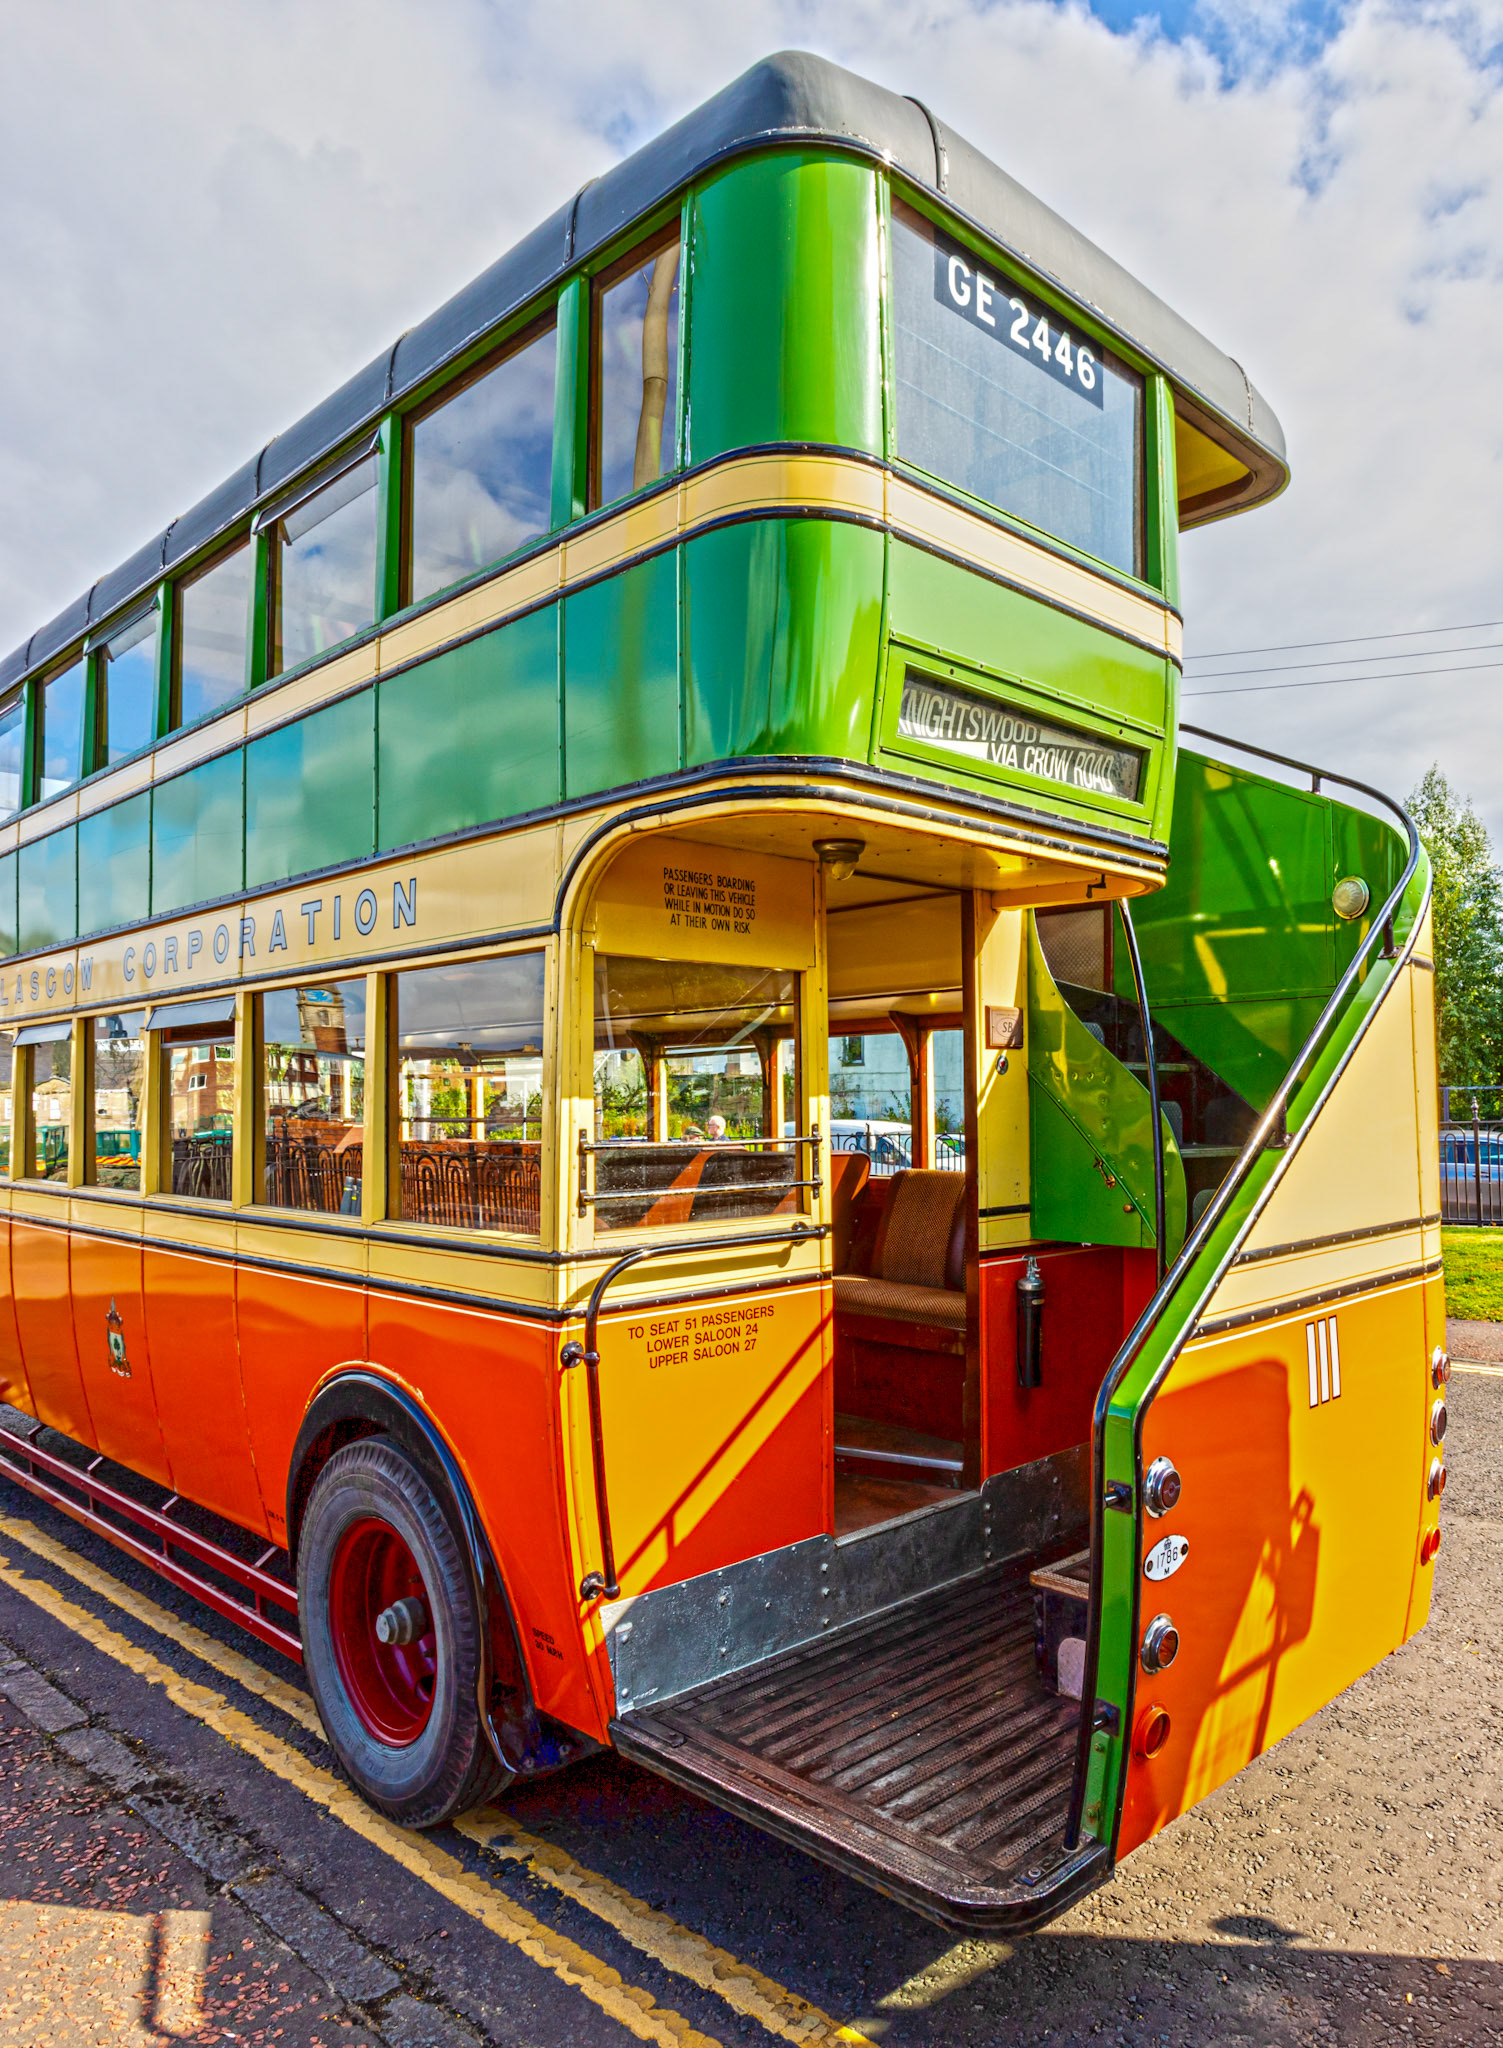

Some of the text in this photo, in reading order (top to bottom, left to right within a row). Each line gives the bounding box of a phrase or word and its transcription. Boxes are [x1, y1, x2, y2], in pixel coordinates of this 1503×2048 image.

[948, 255, 1097, 390] GE 2446
[990, 741, 1114, 793] VIA CROW ROAD
[663, 867, 755, 893] PASSENGERS BOARDING
[664, 882, 755, 906] OR LEAVING THIS VEHICLE
[664, 898, 756, 921] WHILE IN MOTION DO SO
[122, 877, 417, 982] CORPORATION
[670, 913, 751, 934] AT THEIR OWN RISK
[628, 1305, 775, 1340] TO SEAT 51 PASSENGERS
[646, 1323, 758, 1353] LOWER SALOON 24
[649, 1338, 757, 1369] UPPER SALOON 27
[1156, 1547, 1178, 1568] 1786
[1164, 1567, 1170, 1576] M
[532, 1627, 555, 1645] SPEED
[534, 1639, 545, 1651] 30
